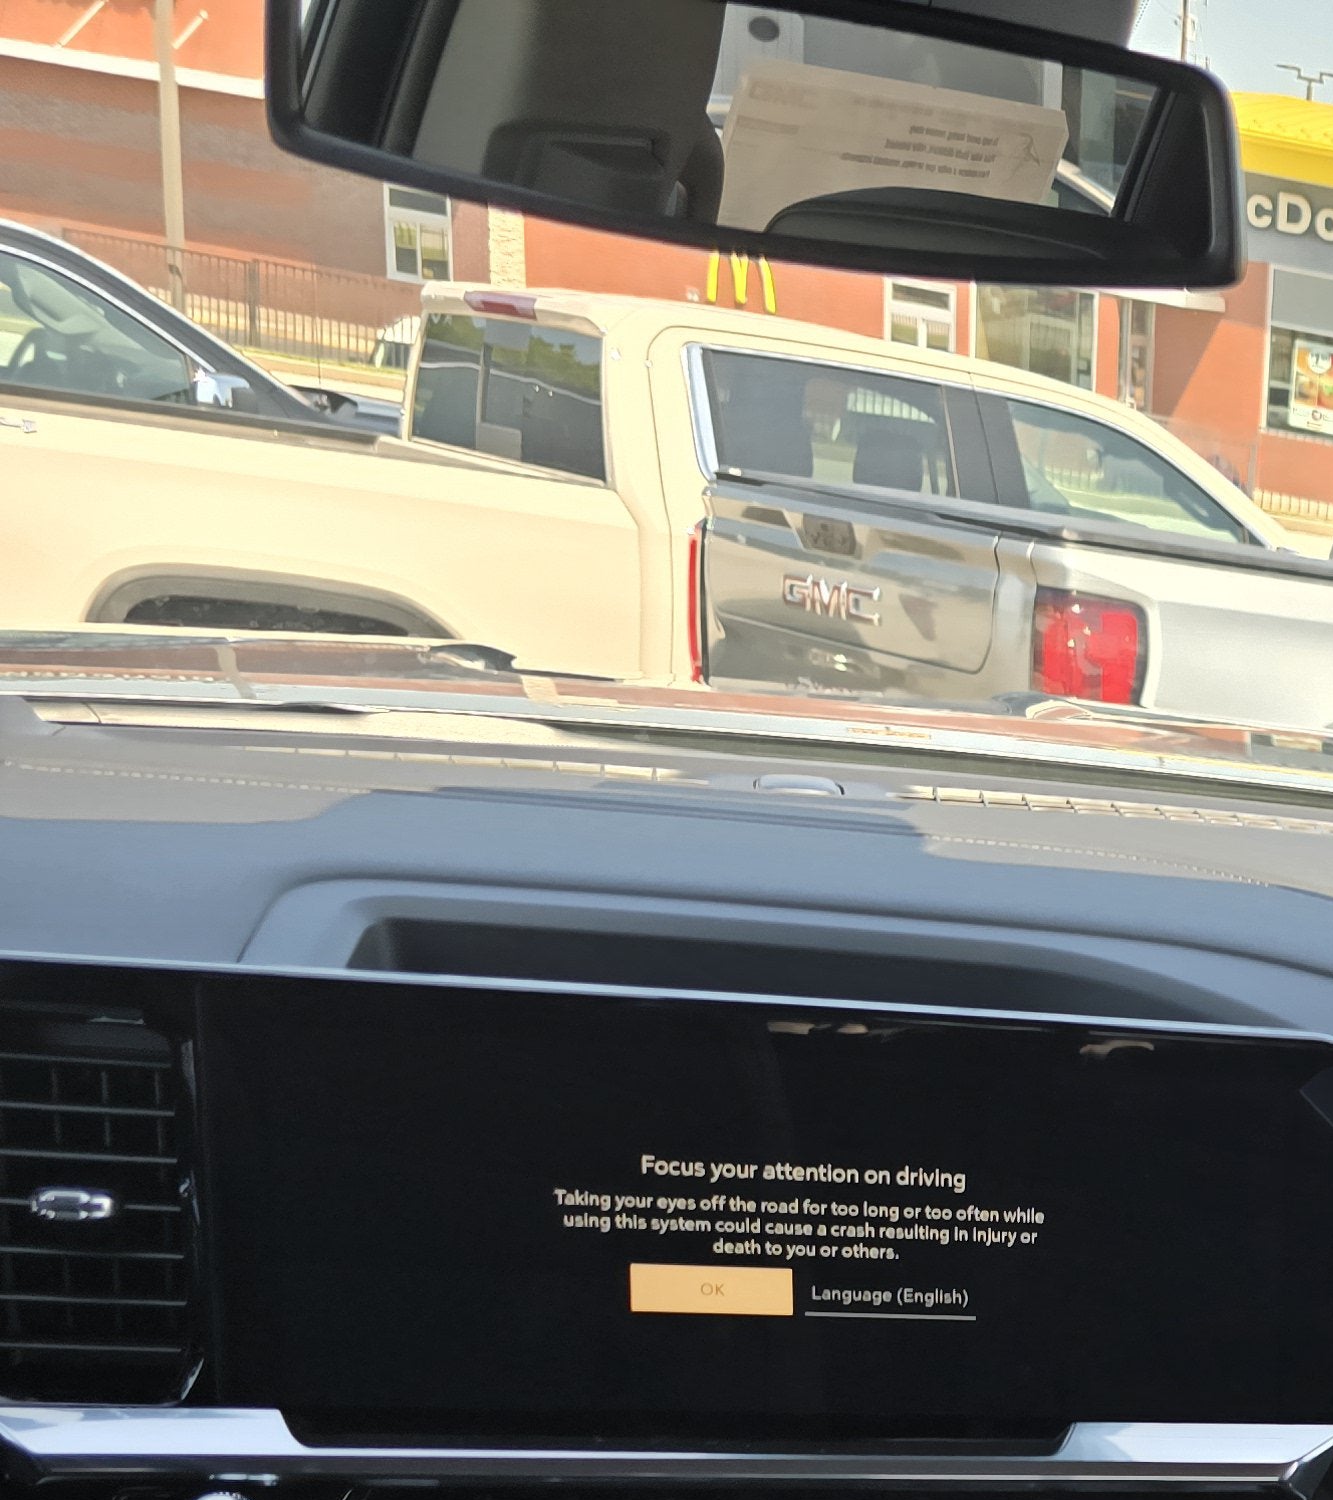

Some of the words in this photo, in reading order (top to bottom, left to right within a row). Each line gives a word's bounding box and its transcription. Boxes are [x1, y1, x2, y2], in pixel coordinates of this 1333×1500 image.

[782, 575, 881, 626] GMC
[641, 1154, 706, 1178] Focus
[710, 1161, 758, 1183] your
[762, 1161, 859, 1184] attention
[864, 1169, 890, 1185] on
[896, 1165, 966, 1193] driving
[553, 1188, 611, 1211] Taking
[614, 1195, 653, 1211] your
[656, 1197, 696, 1213] eyes
[699, 1195, 728, 1211] off
[730, 1195, 757, 1212] the
[761, 1197, 799, 1214] road
[802, 1198, 828, 1215] for
[830, 1201, 859, 1216] too
[863, 1200, 899, 1222] long
[903, 1207, 922, 1219] or
[924, 1205, 952, 1220] too
[956, 1205, 999, 1222] often
[1003, 1206, 1045, 1224] while
[563, 1212, 611, 1232] using
[614, 1212, 647, 1230] this
[650, 1216, 711, 1235] system
[715, 1217, 761, 1234] could
[764, 1222, 813, 1236] cause
[816, 1224, 827, 1236] a
[830, 1221, 875, 1238] crash
[879, 1223, 949, 1245] resulting
[954, 1226, 968, 1241] in
[973, 1226, 1017, 1247] injury
[1020, 1231, 1038, 1244] or
[713, 1237, 761, 1255] death
[765, 1240, 783, 1255] to
[785, 1244, 816, 1260] you
[819, 1245, 839, 1257] or
[841, 1242, 899, 1260] others.
[700, 1282, 726, 1297] OK
[811, 1285, 892, 1306] Language
[896, 1287, 969, 1308] (English)
